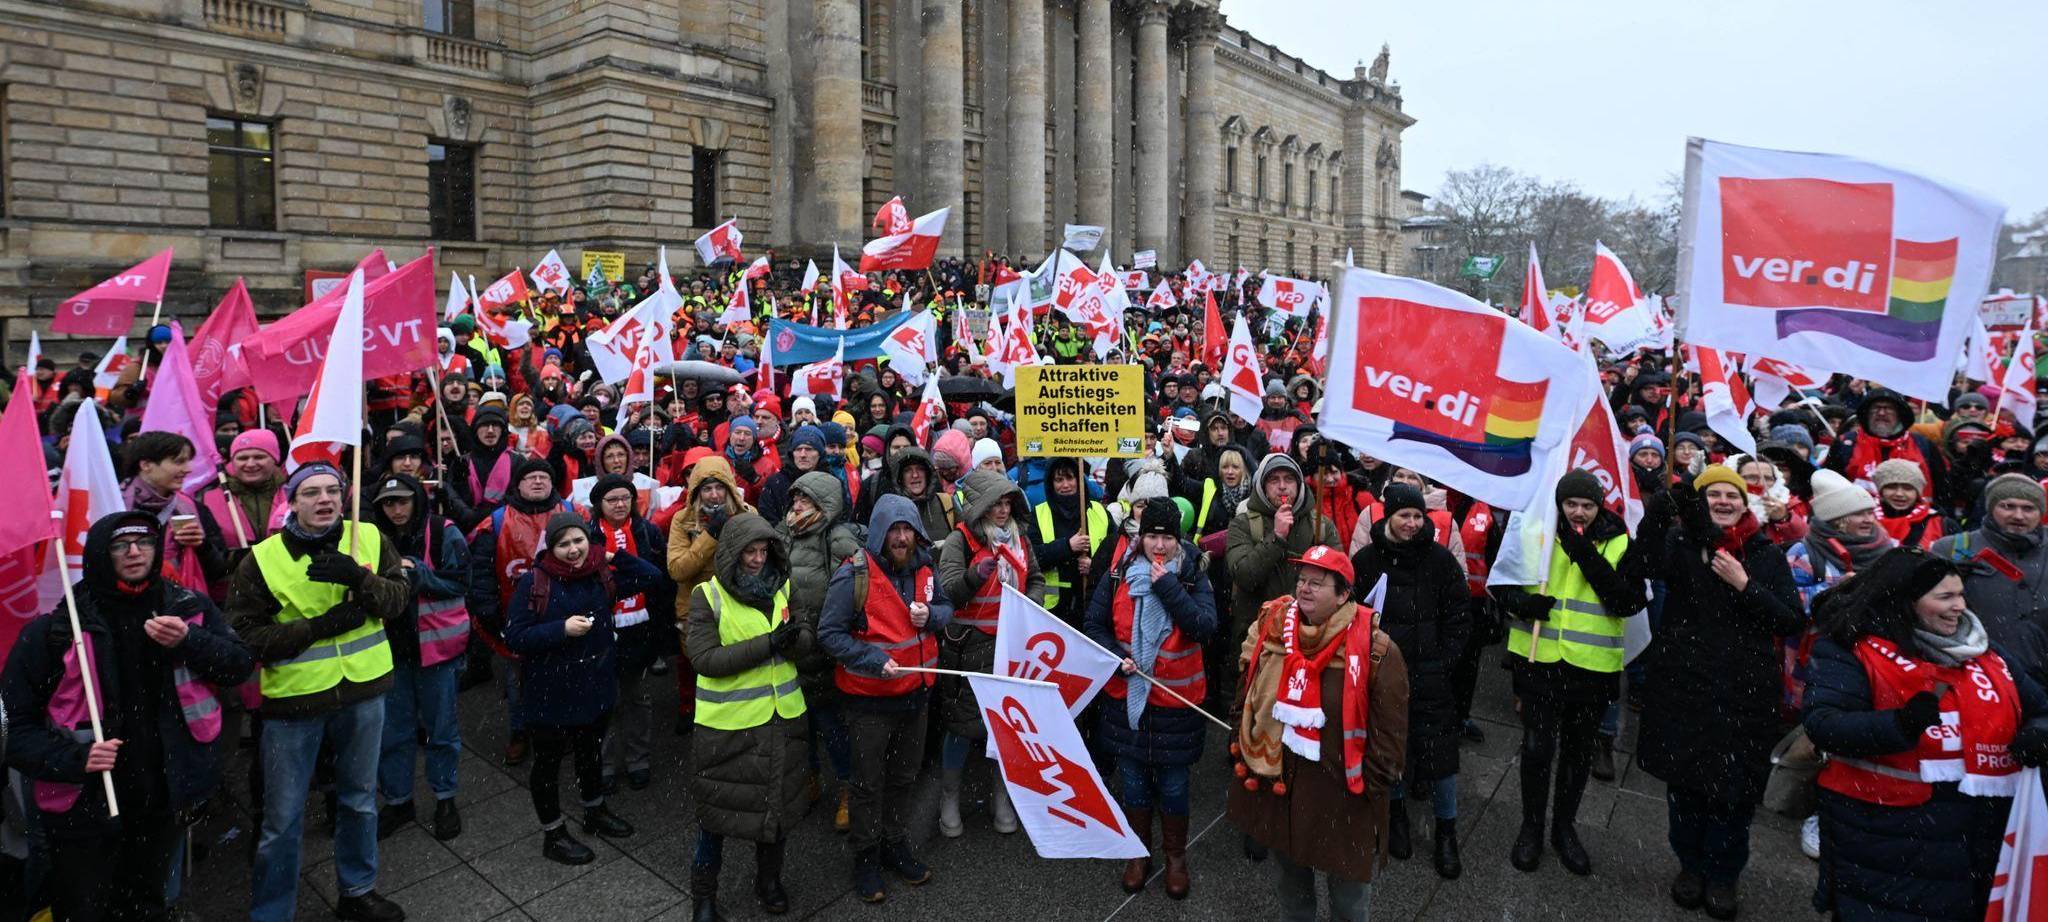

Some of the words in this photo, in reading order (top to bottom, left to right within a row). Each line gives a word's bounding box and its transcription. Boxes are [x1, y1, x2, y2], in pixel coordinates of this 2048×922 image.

[1731, 254, 1878, 295] ver.di
[1039, 368, 1119, 382] Attraktive
[1039, 385, 1120, 401] Aufstiegs-
[1364, 366, 1480, 426] ver.di
[1023, 402, 1136, 418] möglichkeiten
[1041, 419, 1109, 432] schaffen
[1122, 440, 1139, 448] SLV
[1002, 696, 1087, 829] GEW
